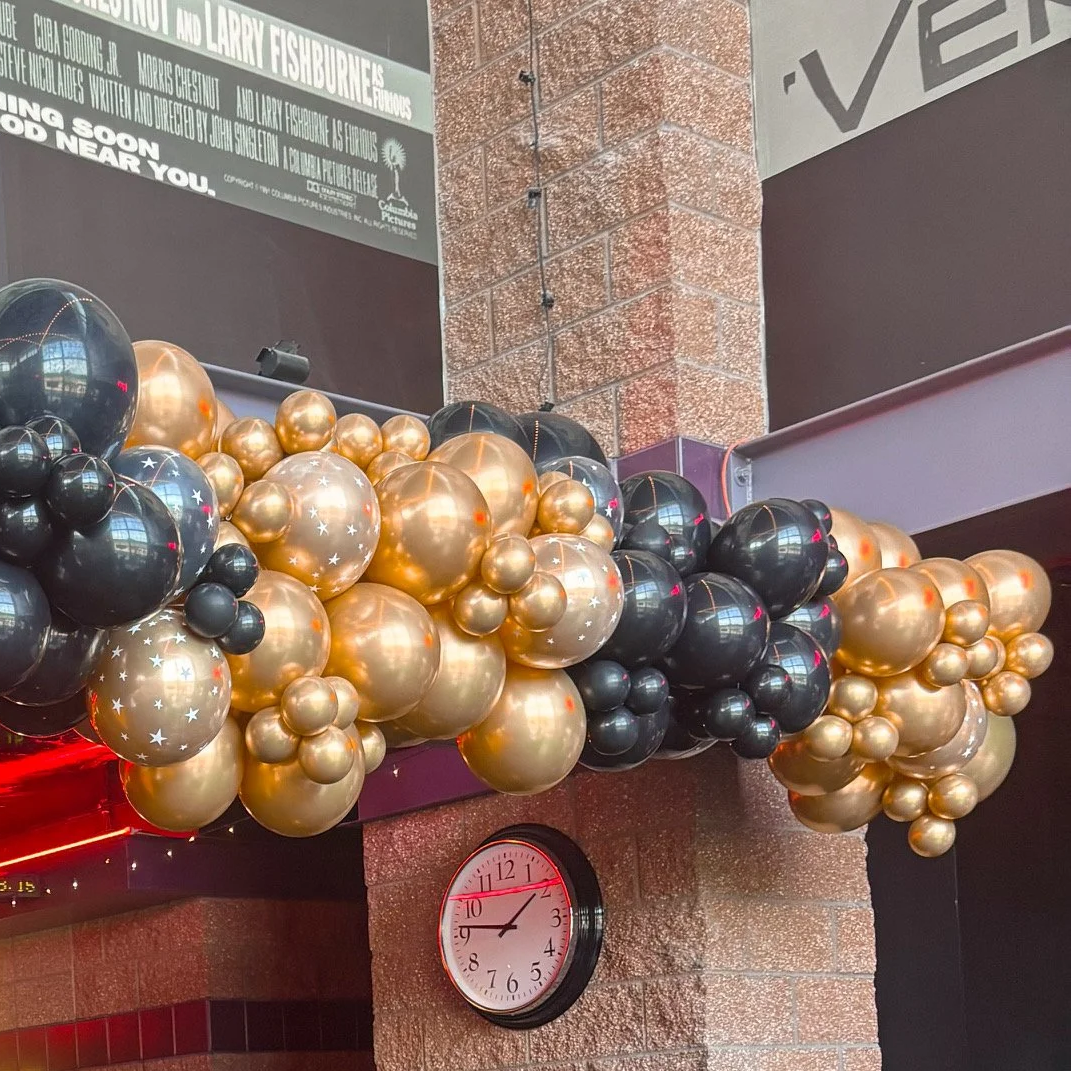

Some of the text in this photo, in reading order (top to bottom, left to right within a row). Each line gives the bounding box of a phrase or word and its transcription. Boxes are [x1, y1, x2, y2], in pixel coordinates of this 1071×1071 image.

[176, 8, 201, 46] AND
[205, 0, 264, 69] LARRY
[269, 24, 372, 107] FISHBURNE
[371, 62, 385, 89] AS
[33, 13, 61, 57] CUBA
[137, 51, 173, 96] MORRIS
[174, 63, 220, 111] CHESTNUT
[236, 85, 255, 123] AND
[256, 92, 283, 132] LARRY
[284, 101, 329, 148] FISHBURNE
[332, 118, 344, 152] AS
[345, 126, 379, 163] FURIOUS
[372, 87, 413, 121] FURIOUS
[28, 51, 84, 105] NICOLAIDES
[89, 73, 132, 121] WRITTEN
[134, 89, 153, 128] AND
[154, 95, 195, 141] DIRECTED
[195, 109, 208, 145] BY
[210, 114, 233, 153] JOHN
[234, 122, 280, 168] SINGLETON
[289, 148, 321, 180] COLUMBIA
[323, 158, 352, 192] PICTURES
[352, 168, 379, 200] RELEASE
[71, 117, 160, 161] SOON
[56, 131, 140, 174] NEAR
[147, 160, 216, 197] YOU.
[378, 199, 418, 221] Columbia
[381, 211, 416, 230] Pictures
[496, 859, 516, 881] 12
[526, 864, 532, 882] 1
[479, 874, 492, 893] 11
[540, 878, 552, 899] 2
[465, 899, 482, 919] 10
[550, 908, 561, 928] 3
[459, 926, 471, 946] 9
[544, 937, 556, 957] 4
[469, 953, 480, 972] 8
[530, 961, 542, 981] 5
[487, 970, 497, 989] 7
[506, 972, 518, 994] 6
